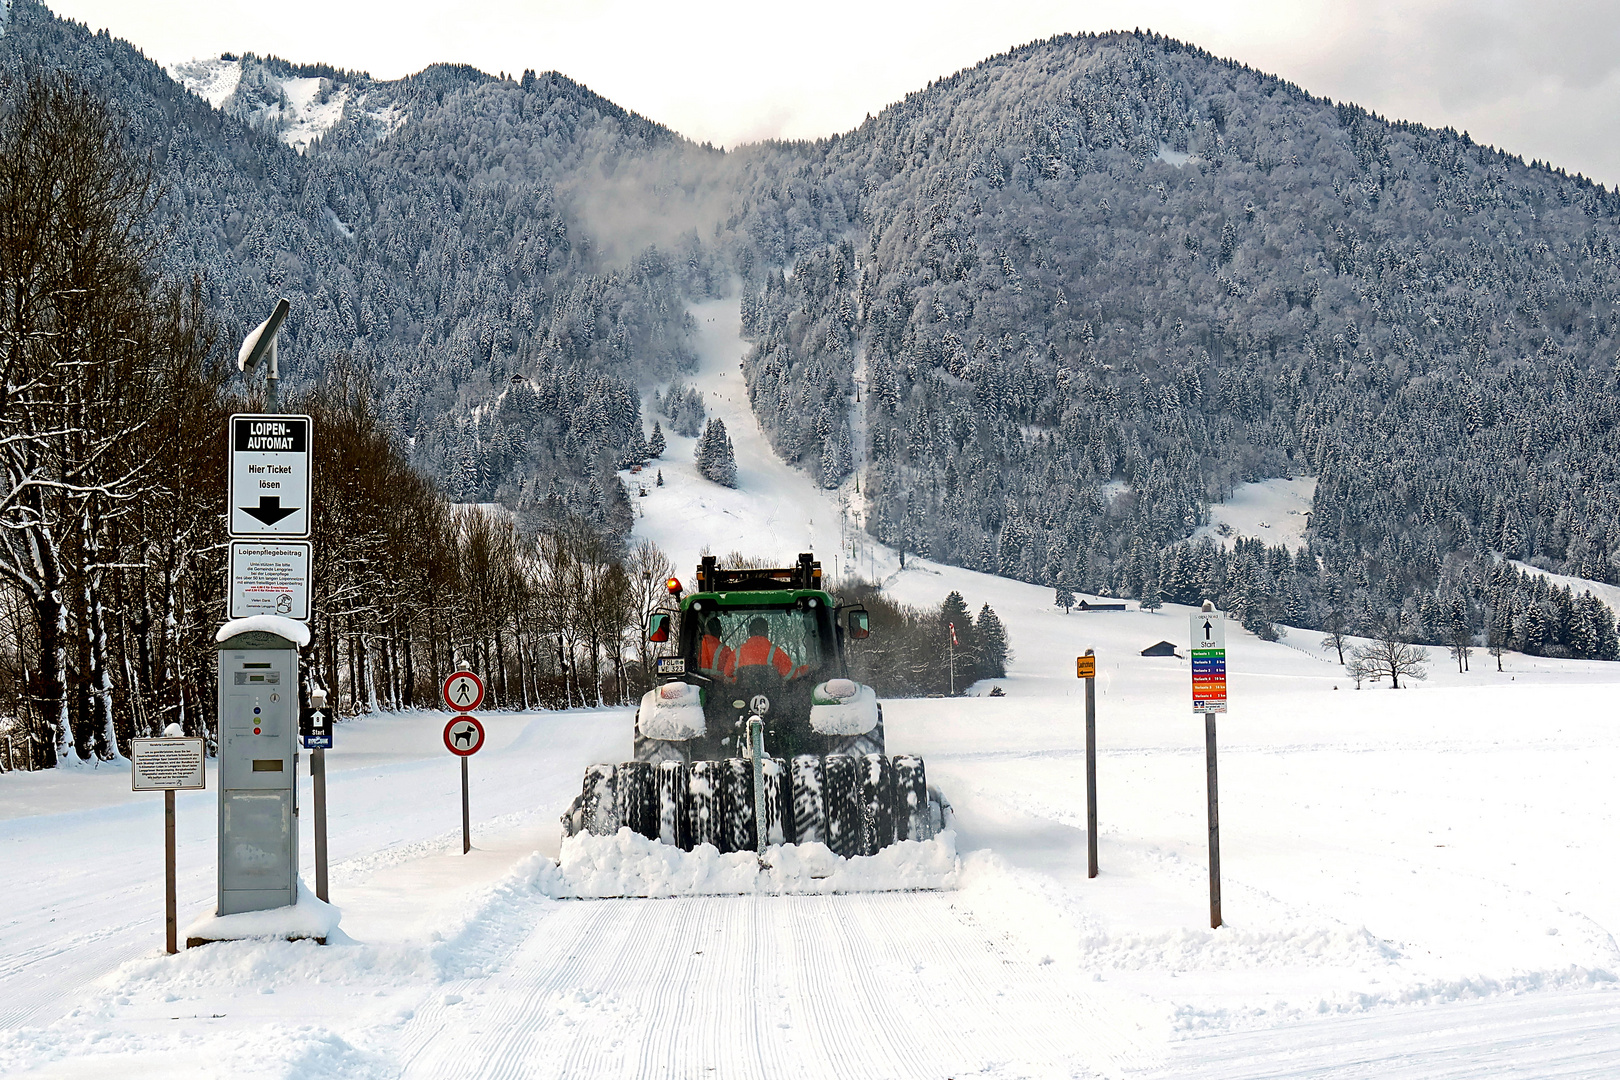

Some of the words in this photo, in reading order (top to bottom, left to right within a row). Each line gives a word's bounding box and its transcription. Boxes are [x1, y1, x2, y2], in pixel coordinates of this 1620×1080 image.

[250, 423, 291, 435] LOIPEN-
[248, 437, 293, 449] AUTOMAT
[248, 465, 265, 474] Hier
[267, 465, 292, 474] Ticket
[259, 480, 280, 488] lösen
